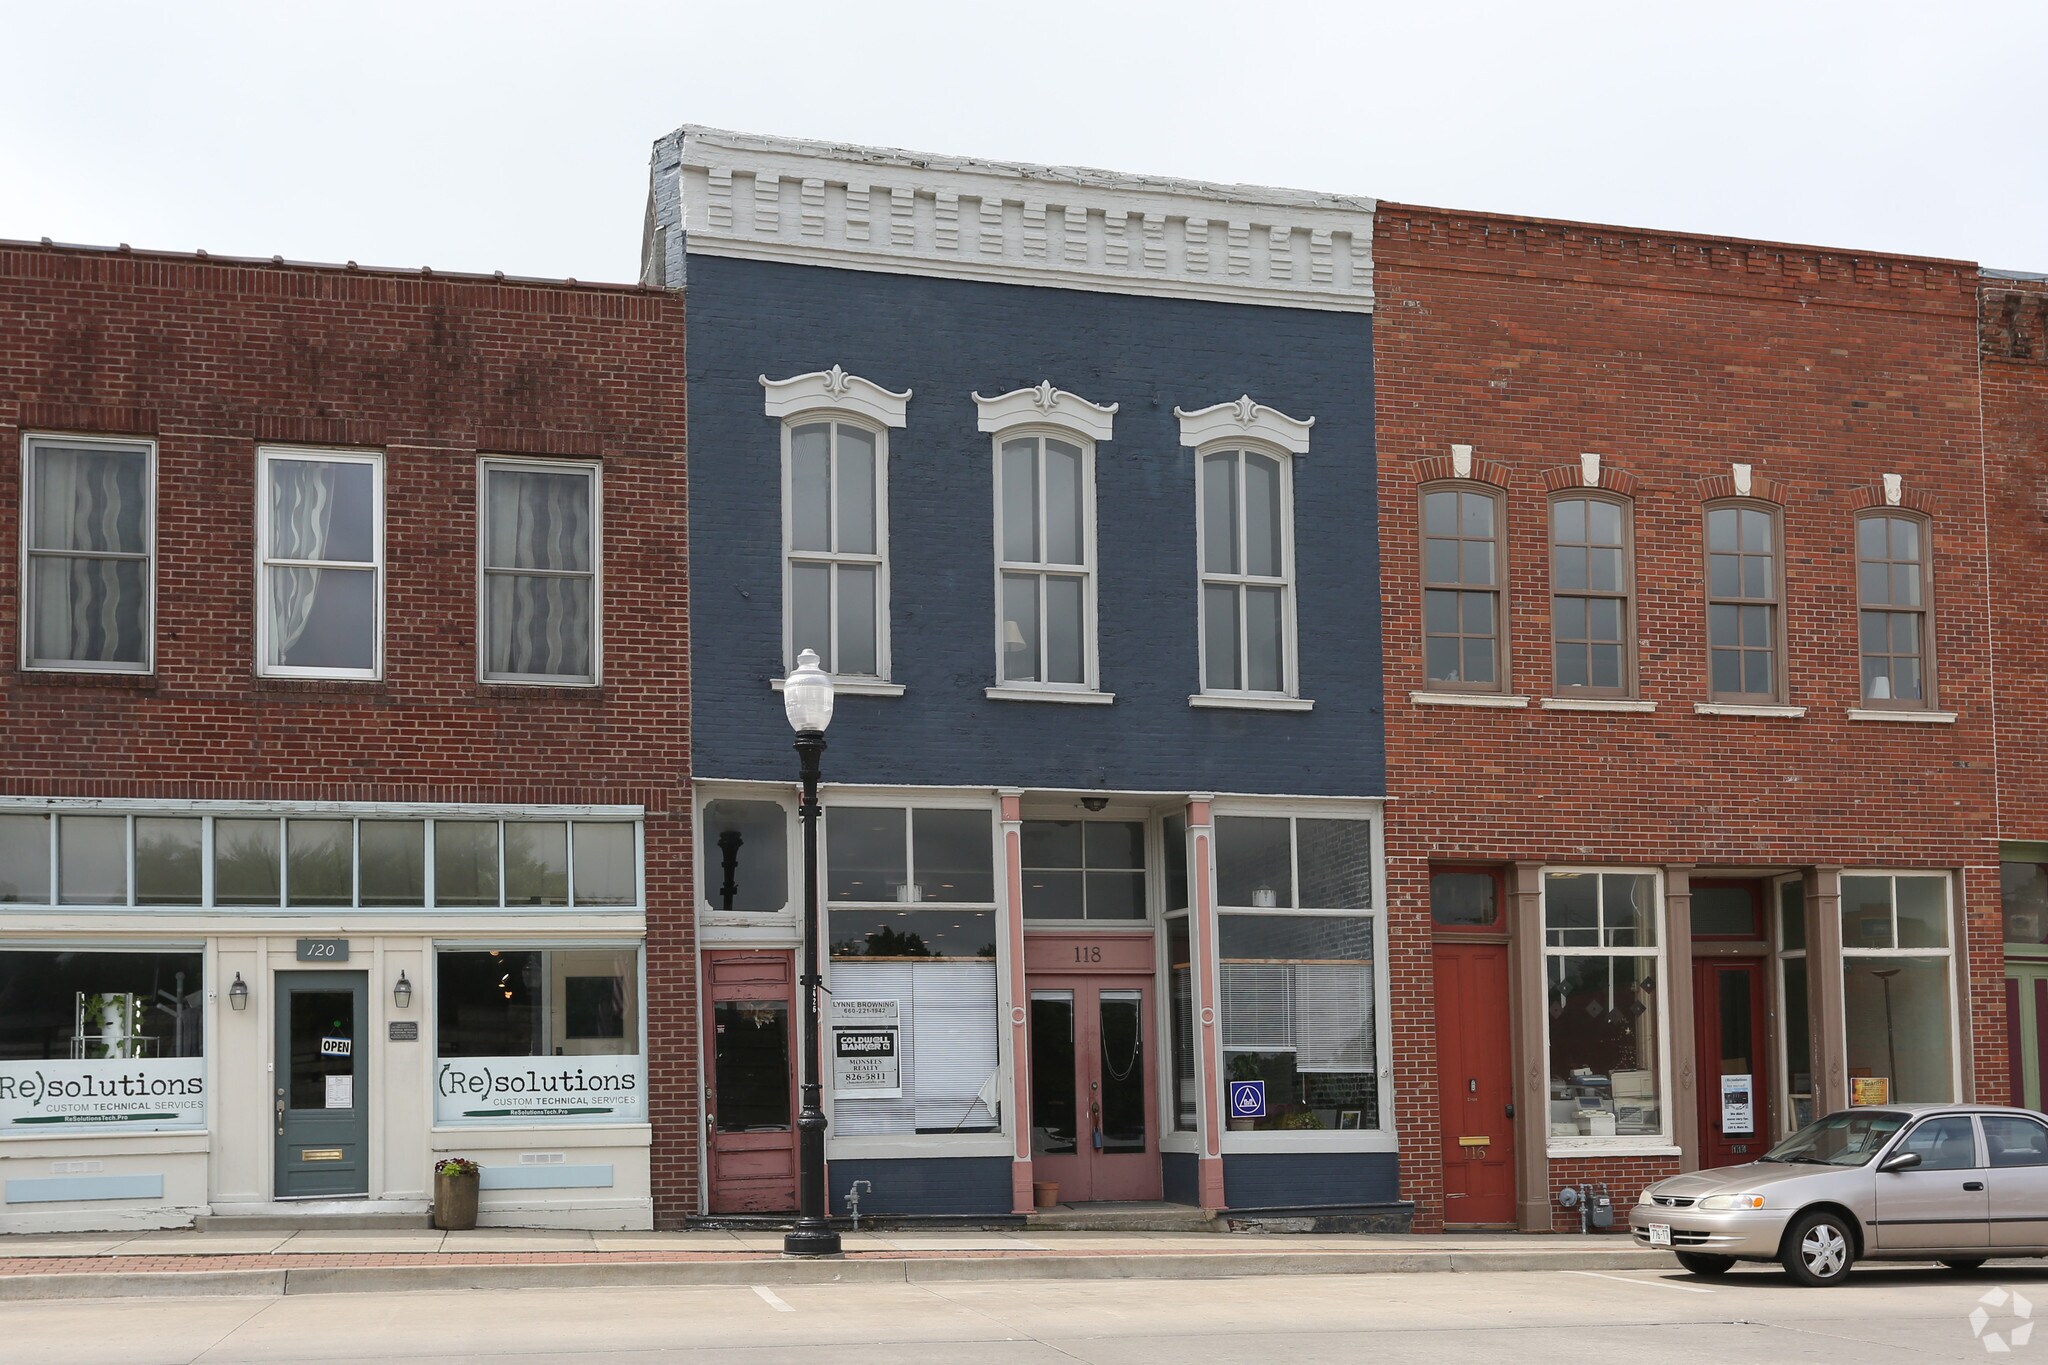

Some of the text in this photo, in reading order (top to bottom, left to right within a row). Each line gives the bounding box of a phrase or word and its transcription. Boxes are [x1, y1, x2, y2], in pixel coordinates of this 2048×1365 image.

[307, 943, 335, 956] 120
[1074, 946, 1101, 963] 118
[840, 1036, 890, 1044] COLDWELL
[323, 1040, 350, 1053] OPEN
[841, 1043, 881, 1051] BANKER
[439, 1063, 636, 1102] (Re)solutions
[845, 1073, 886, 1081] 826-5811
[46, 1100, 204, 1113] CUSTOM TECHNICAL SERVICES
[493, 1096, 636, 1106] CUSTOM TECHNICAL SERVICES
[510, 1108, 568, 1116] ReSolutionsTech.Pro
[64, 1114, 128, 1122] ReSolutionsTech.Pro
[1463, 1146, 1486, 1160] 116
